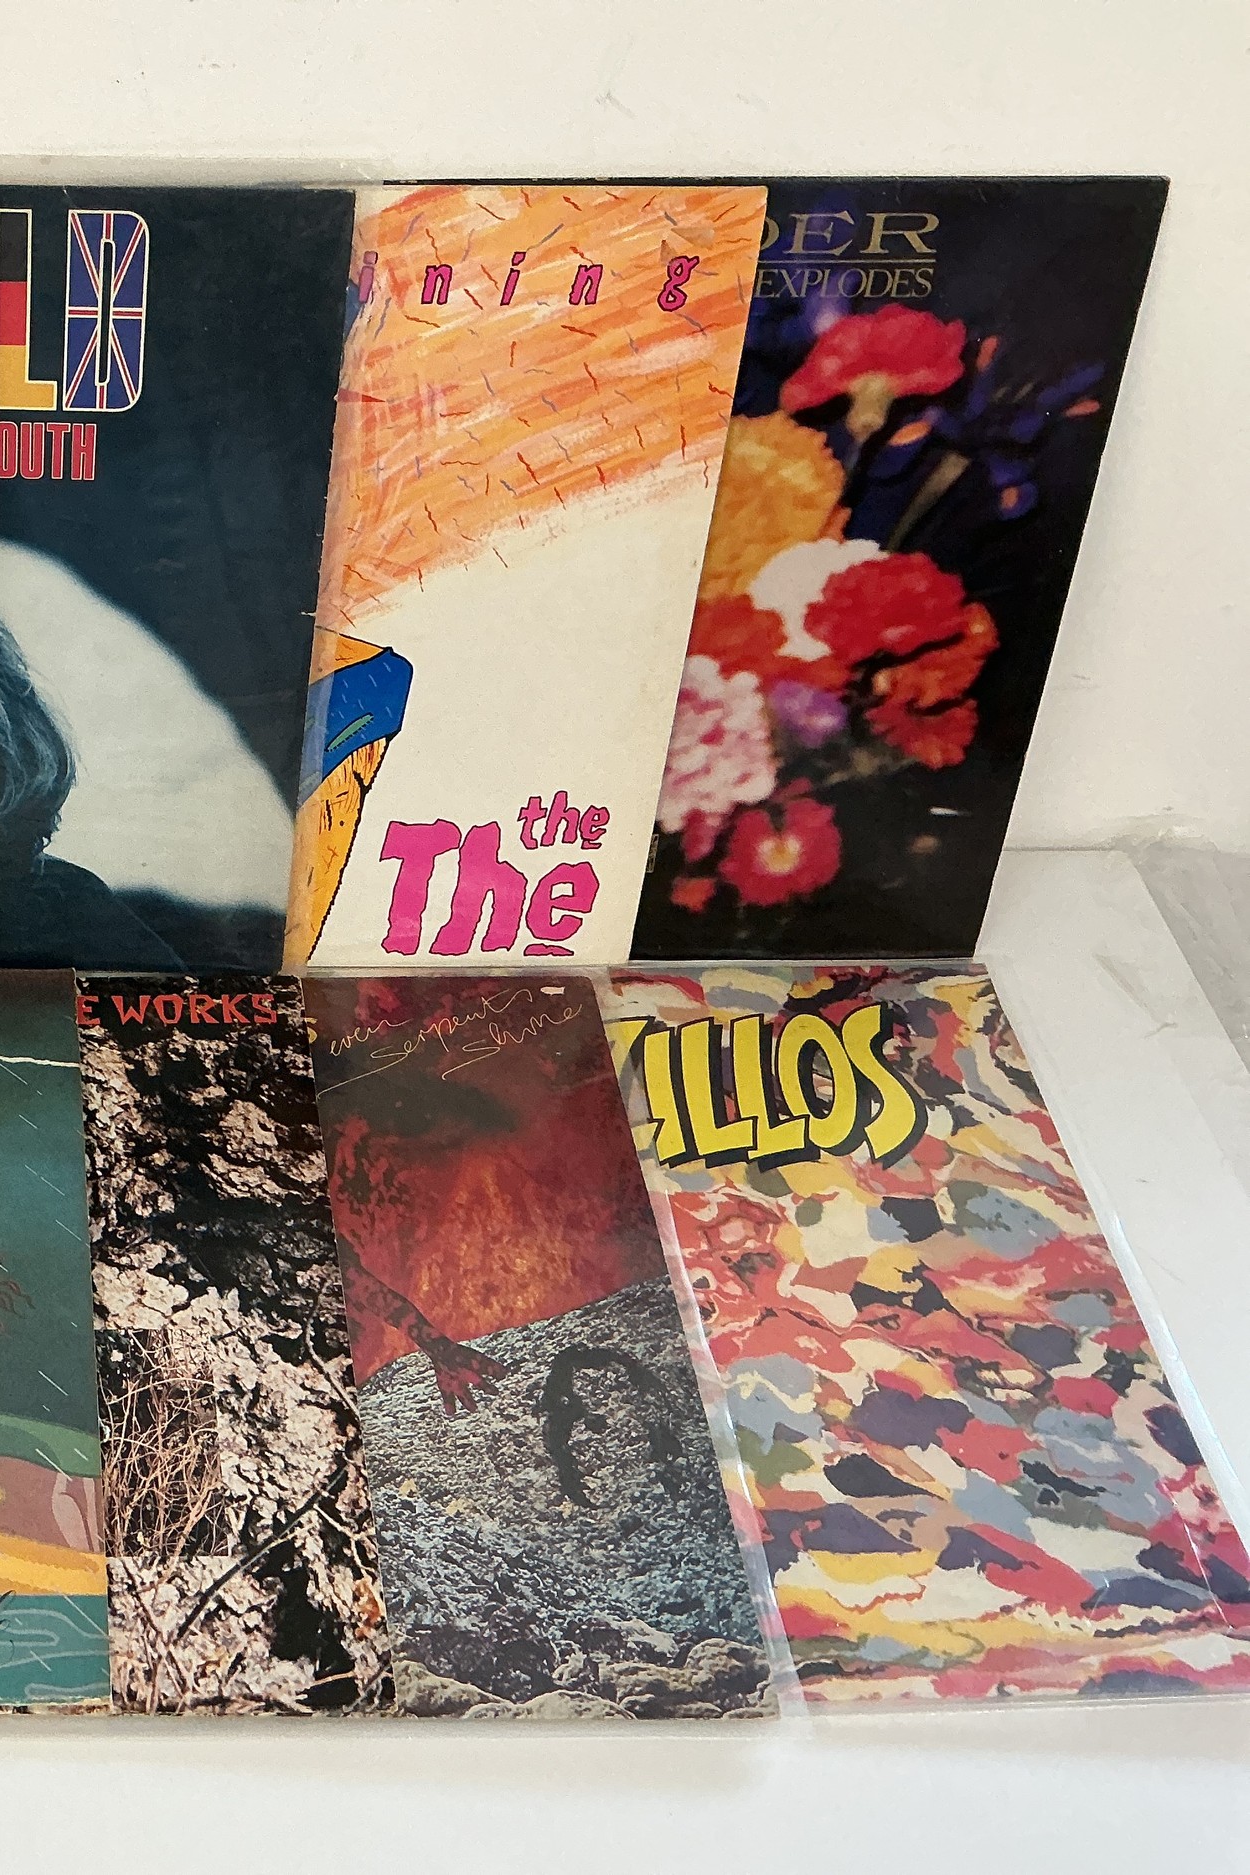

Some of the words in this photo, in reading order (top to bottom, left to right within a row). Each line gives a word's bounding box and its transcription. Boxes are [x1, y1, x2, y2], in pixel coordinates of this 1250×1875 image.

[754, 267, 934, 298] EXPLODES
[517, 790, 610, 849] the
[379, 818, 600, 956] The
[110, 993, 277, 1026] WORKS
